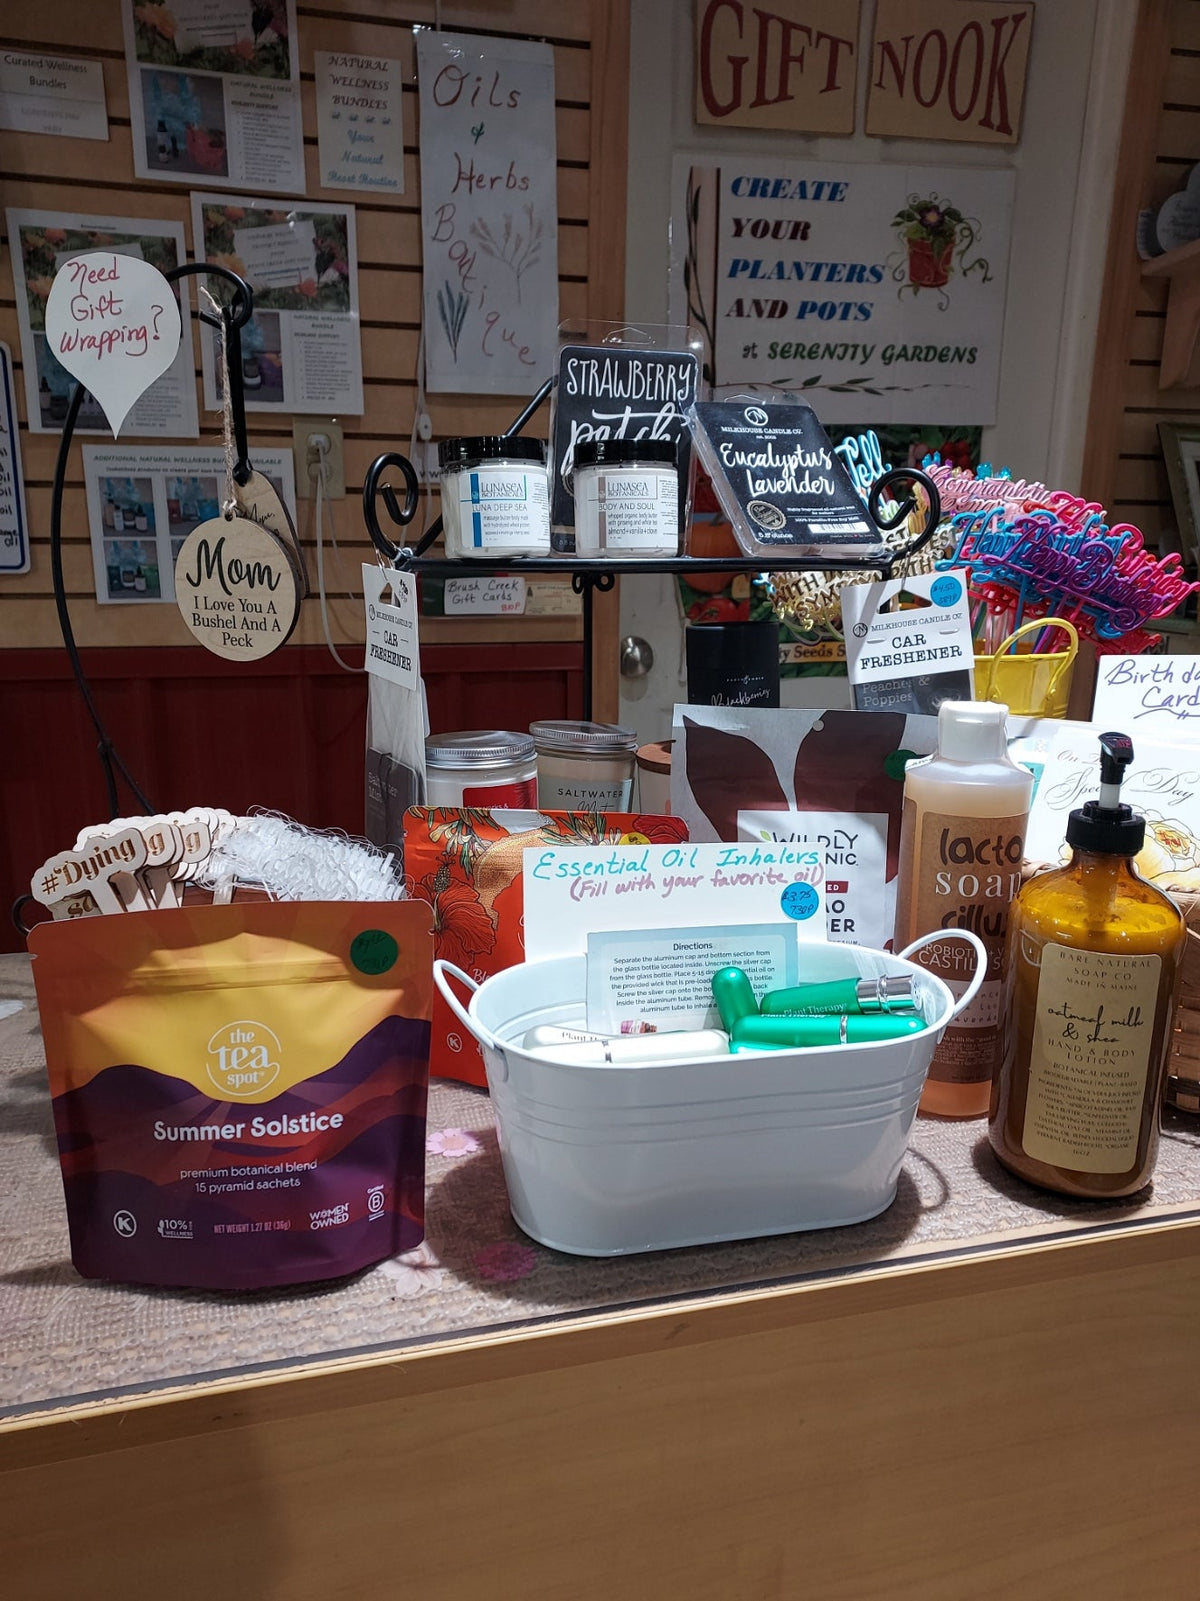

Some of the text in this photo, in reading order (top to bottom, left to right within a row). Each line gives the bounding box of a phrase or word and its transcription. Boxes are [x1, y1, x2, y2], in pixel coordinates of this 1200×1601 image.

[4, 54, 88, 73] Curated Wellness
[328, 56, 388, 72] NATURAL
[700, 0, 1028, 136] GIFT NOOK
[29, 75, 67, 89] Bundles
[329, 74, 390, 91] WELLNESS
[433, 64, 520, 107] Oils
[332, 94, 388, 110] BUNDLES
[341, 151, 384, 165] Natural
[452, 151, 530, 194] Herbs
[730, 176, 850, 202] CREATE
[731, 217, 812, 242] YOUR
[66, 256, 121, 296] Need
[727, 258, 885, 285] PLANTERS
[70, 290, 124, 321] Gift
[725, 298, 874, 322] AND POTS
[60, 304, 164, 361] Wrapping?
[742, 342, 978, 365] at SERENITY GARDENS
[566, 357, 692, 402] STRAWBERRY
[560, 402, 691, 476] patch
[721, 426, 792, 435] MILKHOUSE CANDLE
[720, 442, 833, 478] Eucalyptus
[481, 482, 523, 493] LUNASEA
[607, 482, 649, 492] LUNASEA
[746, 469, 836, 498] Lavender
[472, 503, 528, 512] LUNA DEEP SEA
[599, 503, 617, 511] BODY
[637, 502, 655, 510] SOUL
[186, 536, 281, 597] Mom
[447, 579, 520, 593] Brush Creek
[193, 596, 278, 615] I Love You A
[452, 591, 512, 605] Gift Cards
[192, 612, 282, 633] Bushel And A
[871, 614, 952, 632] MILKHOUSE CANDLE
[222, 631, 254, 648] Peck
[383, 630, 399, 648] CAR
[892, 633, 927, 649] CAR
[370, 644, 412, 672] FRESHENER
[794, 645, 833, 658] Seeds
[860, 645, 963, 670] FRESHENER
[863, 676, 930, 694] Peaches &
[863, 693, 913, 708] Poppies
[1057, 750, 1079, 763] On
[557, 788, 623, 799] SALTWATER
[940, 828, 1023, 866] lacto
[41, 837, 137, 896] #Dying
[532, 846, 820, 881] Essential Oil Inhalers
[569, 862, 825, 902] (Fill with your favorite oil)
[935, 871, 1021, 902] soap
[782, 887, 814, 902] $3.75
[673, 942, 713, 952] Directions
[614, 957, 641, 966] Separate
[653, 953, 684, 963] aluminum
[685, 954, 697, 963] cap
[697, 952, 709, 960] and
[709, 951, 732, 959] bottom
[733, 950, 755, 958] section
[755, 949, 771, 957] from
[624, 966, 640, 975] glass
[641, 963, 660, 971] bottle
[661, 961, 684, 970] located
[704, 959, 731, 967] Unscrew
[731, 958, 742, 966] the
[742, 957, 759, 965] silver
[918, 950, 977, 972] CASTIL
[1059, 950, 1152, 969] BARE NATURAL
[609, 969, 691, 982] from the glass bottle. Place
[1074, 967, 1108, 979] SOAP
[611, 982, 622, 990] the
[622, 981, 650, 991] provided
[650, 979, 665, 987] wick
[1065, 977, 1091, 989] MADE
[616, 995, 677, 1006] Inside the aluminum
[617, 990, 636, 998] Screw
[637, 989, 648, 997] the
[648, 988, 664, 997] silver
[665, 989, 677, 997] cap
[677, 987, 692, 995] onto
[640, 1002, 713, 1013] aluminum tube inhale
[783, 1006, 807, 1016] Plant
[806, 1003, 846, 1014] Therapy
[1047, 1002, 1144, 1028] oatmeal milk
[229, 1028, 256, 1044] the
[1062, 1022, 1119, 1043] & shea
[1048, 1038, 1136, 1058] HAND BODY
[216, 1044, 272, 1072] tea
[1066, 1053, 1117, 1066] LOTION
[1053, 1062, 1130, 1079] BOTANICAL INFUSED
[227, 1071, 259, 1089] spot
[153, 1111, 344, 1142] Summer Solstice
[180, 1158, 319, 1180] premium botanical blend
[194, 1177, 301, 1195] 15 pyramid sachets
[309, 1202, 350, 1221] WOMEN
[310, 1211, 350, 1230] OWNED
[164, 1219, 188, 1231] 10%
[213, 1222, 263, 1234] NET WEIGHT 1.27
